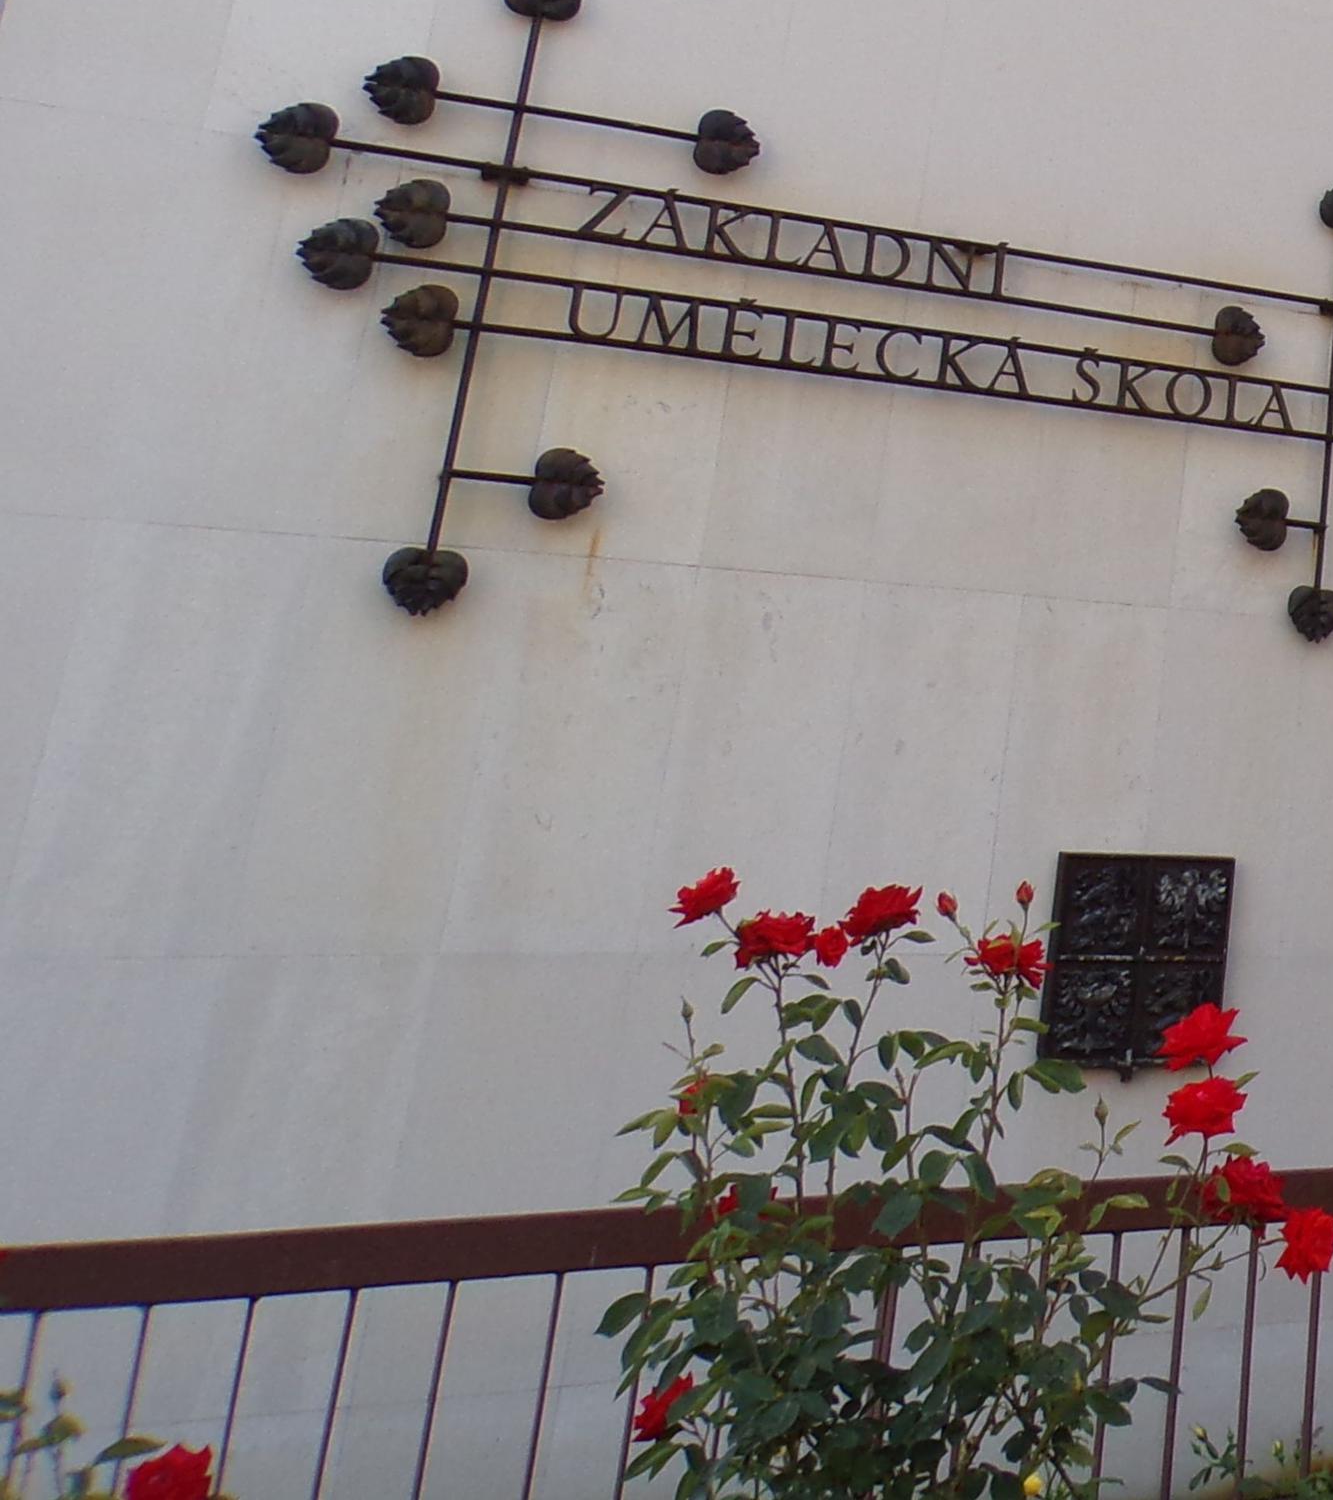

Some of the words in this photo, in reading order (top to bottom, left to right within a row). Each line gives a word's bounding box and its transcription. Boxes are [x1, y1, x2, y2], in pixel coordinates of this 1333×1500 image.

[578, 187, 1009, 296] ZÁKLADNÍ
[566, 284, 1030, 396] UMĚLECKÁ
[1071, 345, 1296, 432] ŠKOLA
